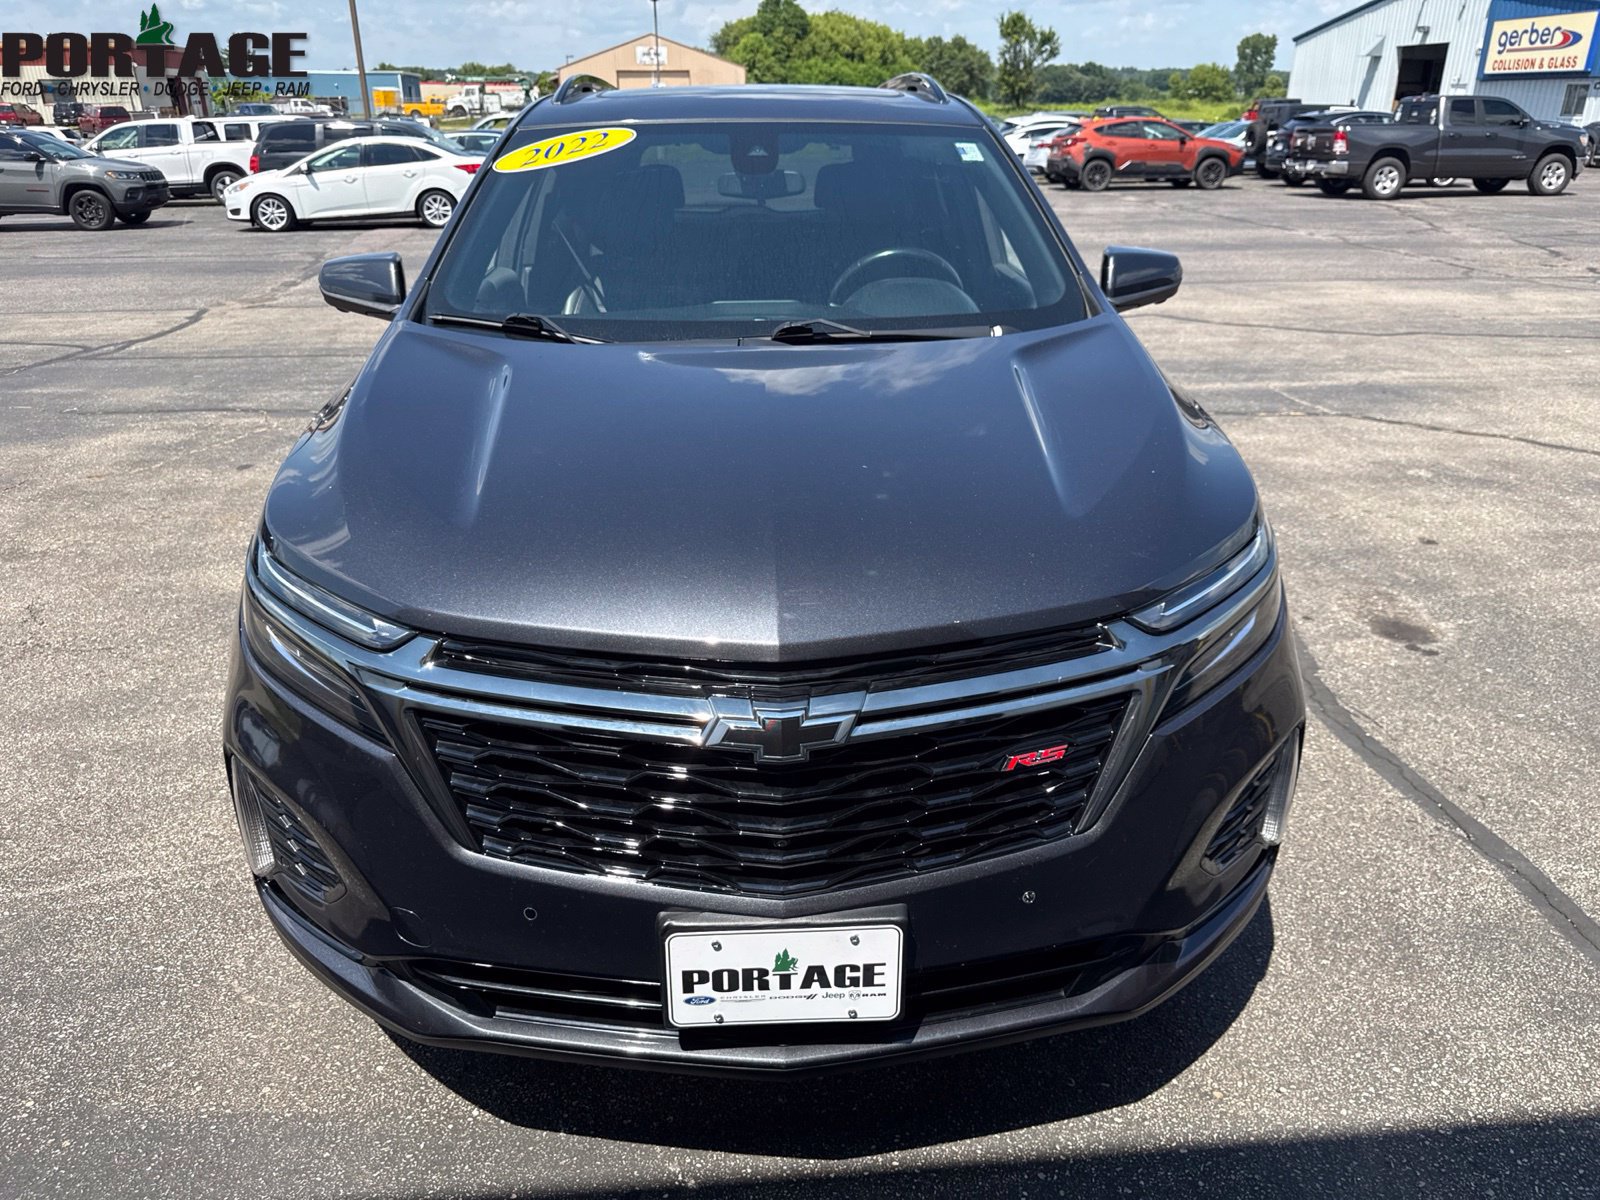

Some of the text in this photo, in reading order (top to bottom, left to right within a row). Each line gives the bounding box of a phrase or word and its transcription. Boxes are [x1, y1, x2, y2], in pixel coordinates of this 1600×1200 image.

[1497, 22, 1562, 55] gerber
[1492, 56, 1578, 71] COLLISION & GLASS
[519, 132, 609, 168] 2022
[1001, 744, 1068, 772] RS
[681, 962, 886, 994] PORTAGE
[822, 991, 846, 1000] Jeep
